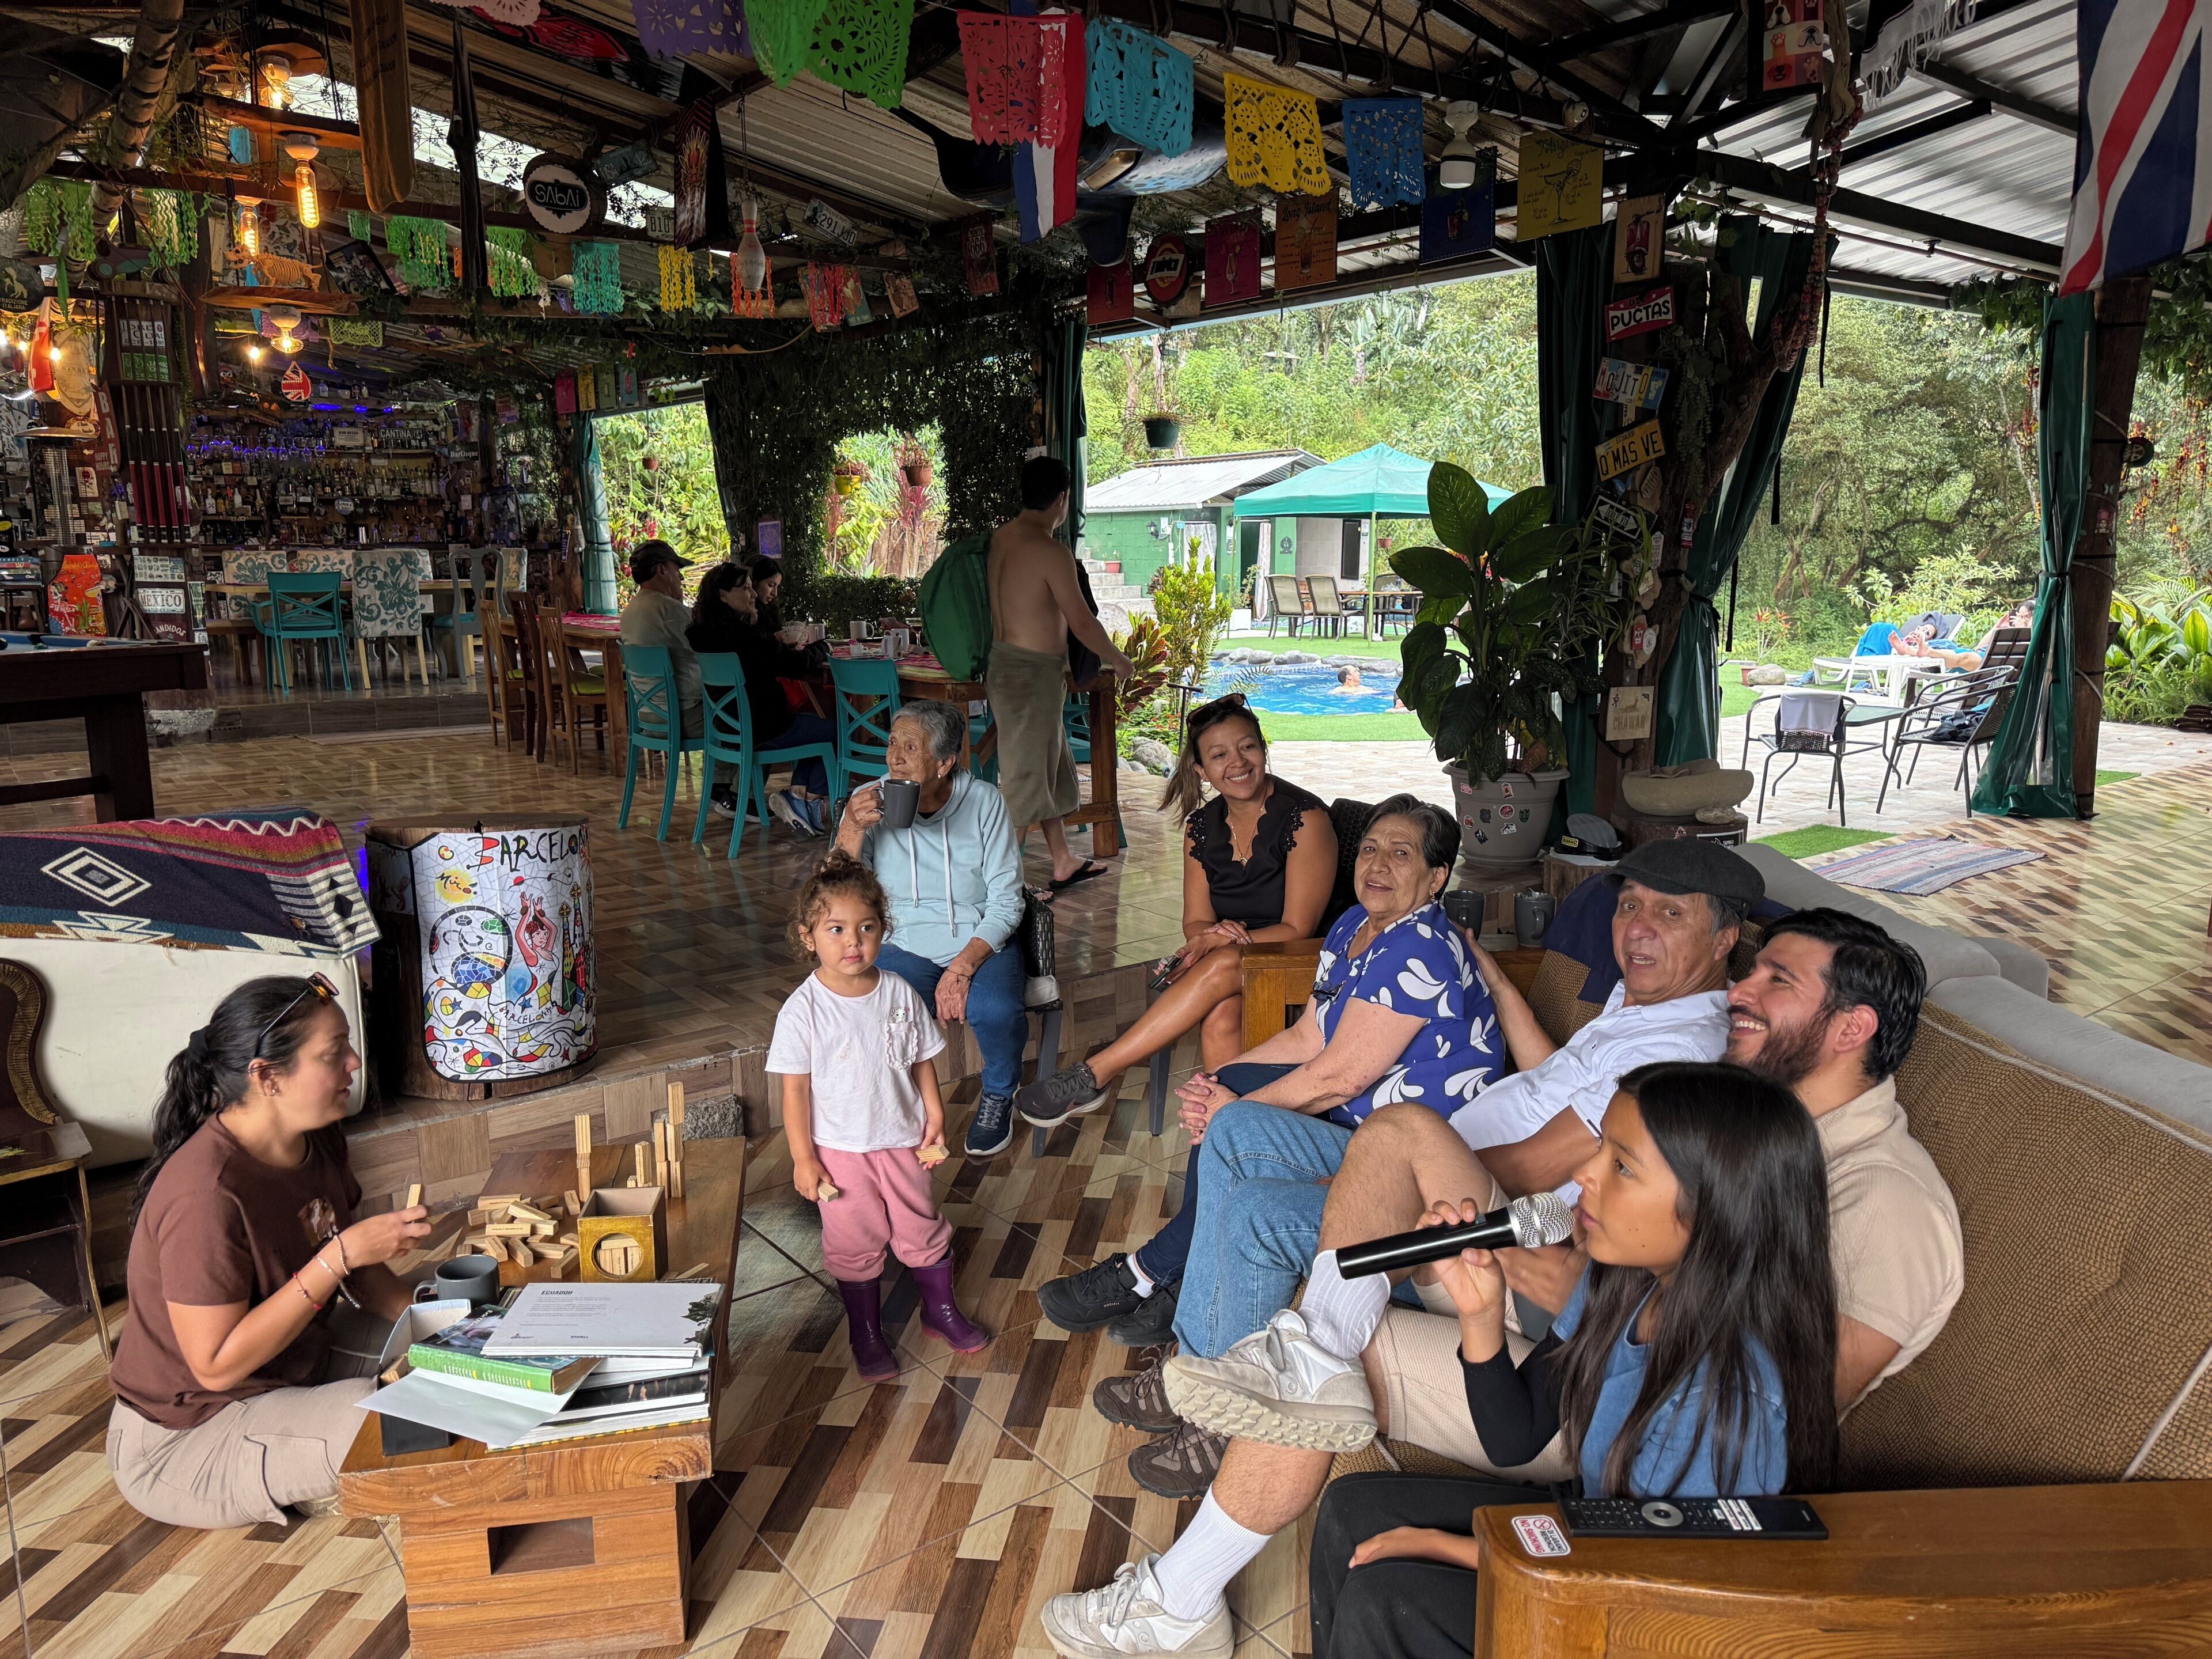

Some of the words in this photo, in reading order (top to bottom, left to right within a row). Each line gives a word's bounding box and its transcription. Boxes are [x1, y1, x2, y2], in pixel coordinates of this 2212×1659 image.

[819, 214, 857, 245] 291JJD
[969, 228, 984, 236] ROUTE
[969, 237, 986, 255] 666
[1611, 300, 1670, 331] PUCTAS
[1598, 367, 1649, 396] MOJITO
[98, 392, 118, 464] BAR
[379, 429, 412, 438] CANTINA
[1616, 430, 1635, 444] ECUADOR
[1641, 430, 1662, 457] VE
[94, 452, 108, 461] HAPPY
[140, 594, 181, 607] MEXICO
[1613, 715, 1645, 731] CHAWAR
[1519, 1520, 1531, 1528] NO
[1524, 1528, 1547, 1554] SMOKING
[1539, 1531, 1558, 1552] MEROKOK
[1550, 1535, 1565, 1552] LARANG
